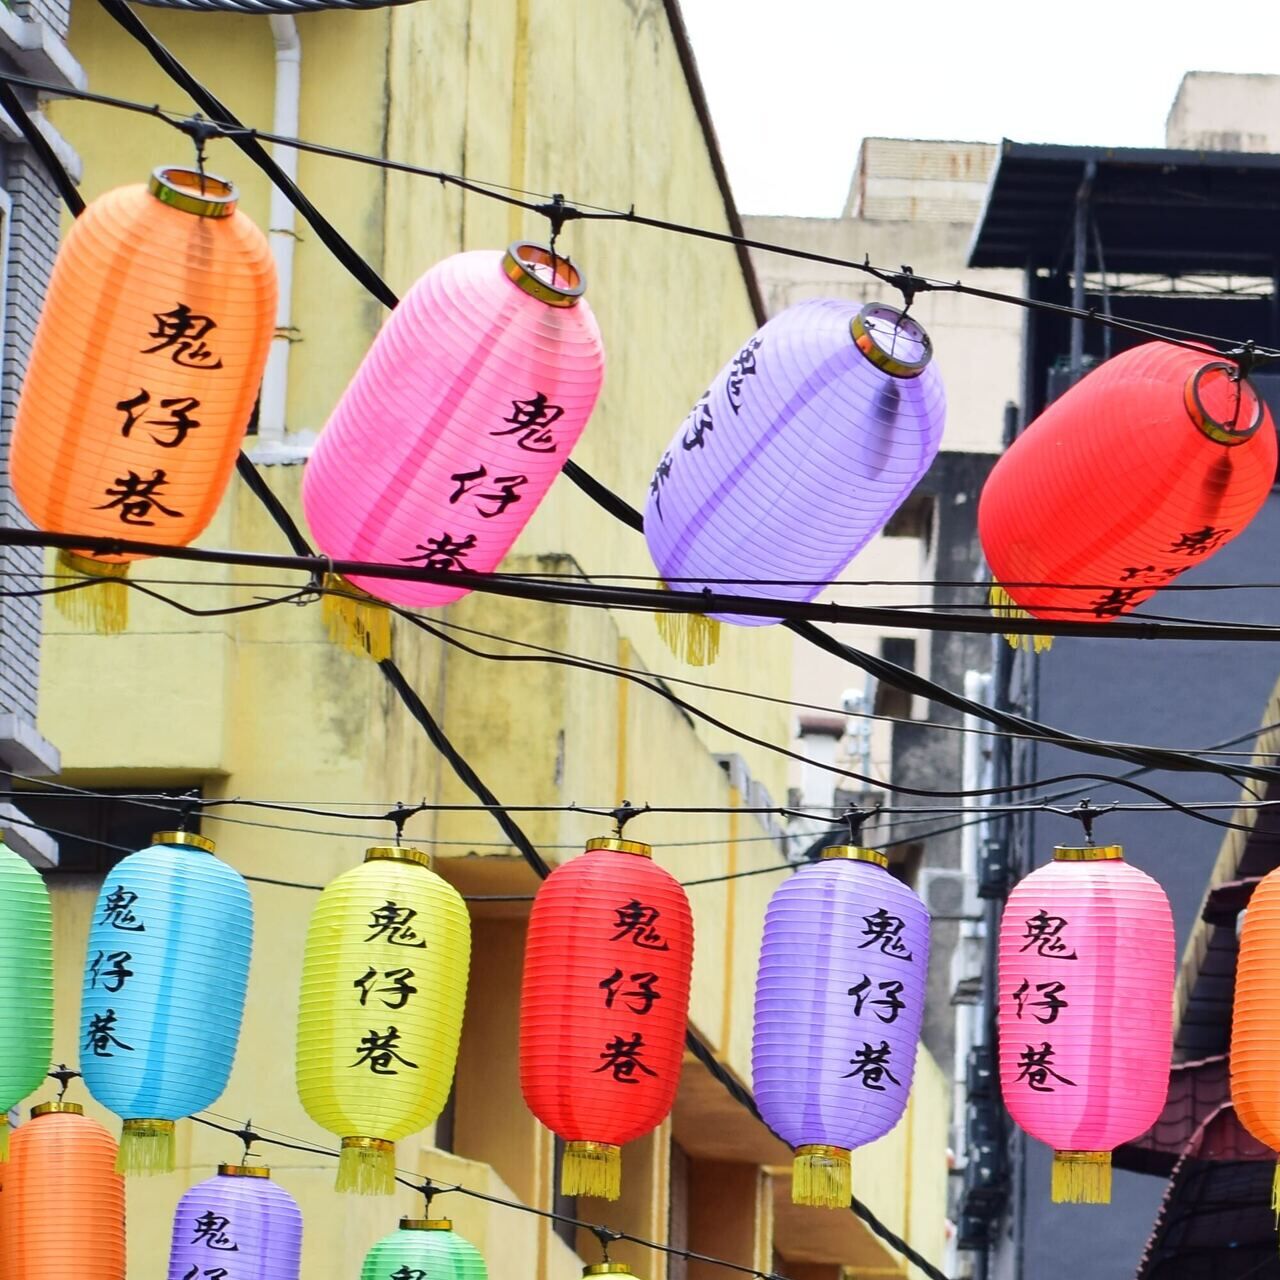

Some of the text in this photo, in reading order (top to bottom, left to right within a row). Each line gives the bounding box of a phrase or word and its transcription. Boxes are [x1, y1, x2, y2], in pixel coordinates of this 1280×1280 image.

[96, 302, 224, 527] 鬼仔巷
[83, 885, 146, 1058] 鬼仔巷
[348, 899, 428, 1076] 鬼仔巷
[595, 899, 671, 1085] 鬼仔巷
[841, 907, 914, 1092] 鬼仔巷
[1011, 908, 1079, 1093] 鬼仔巷
